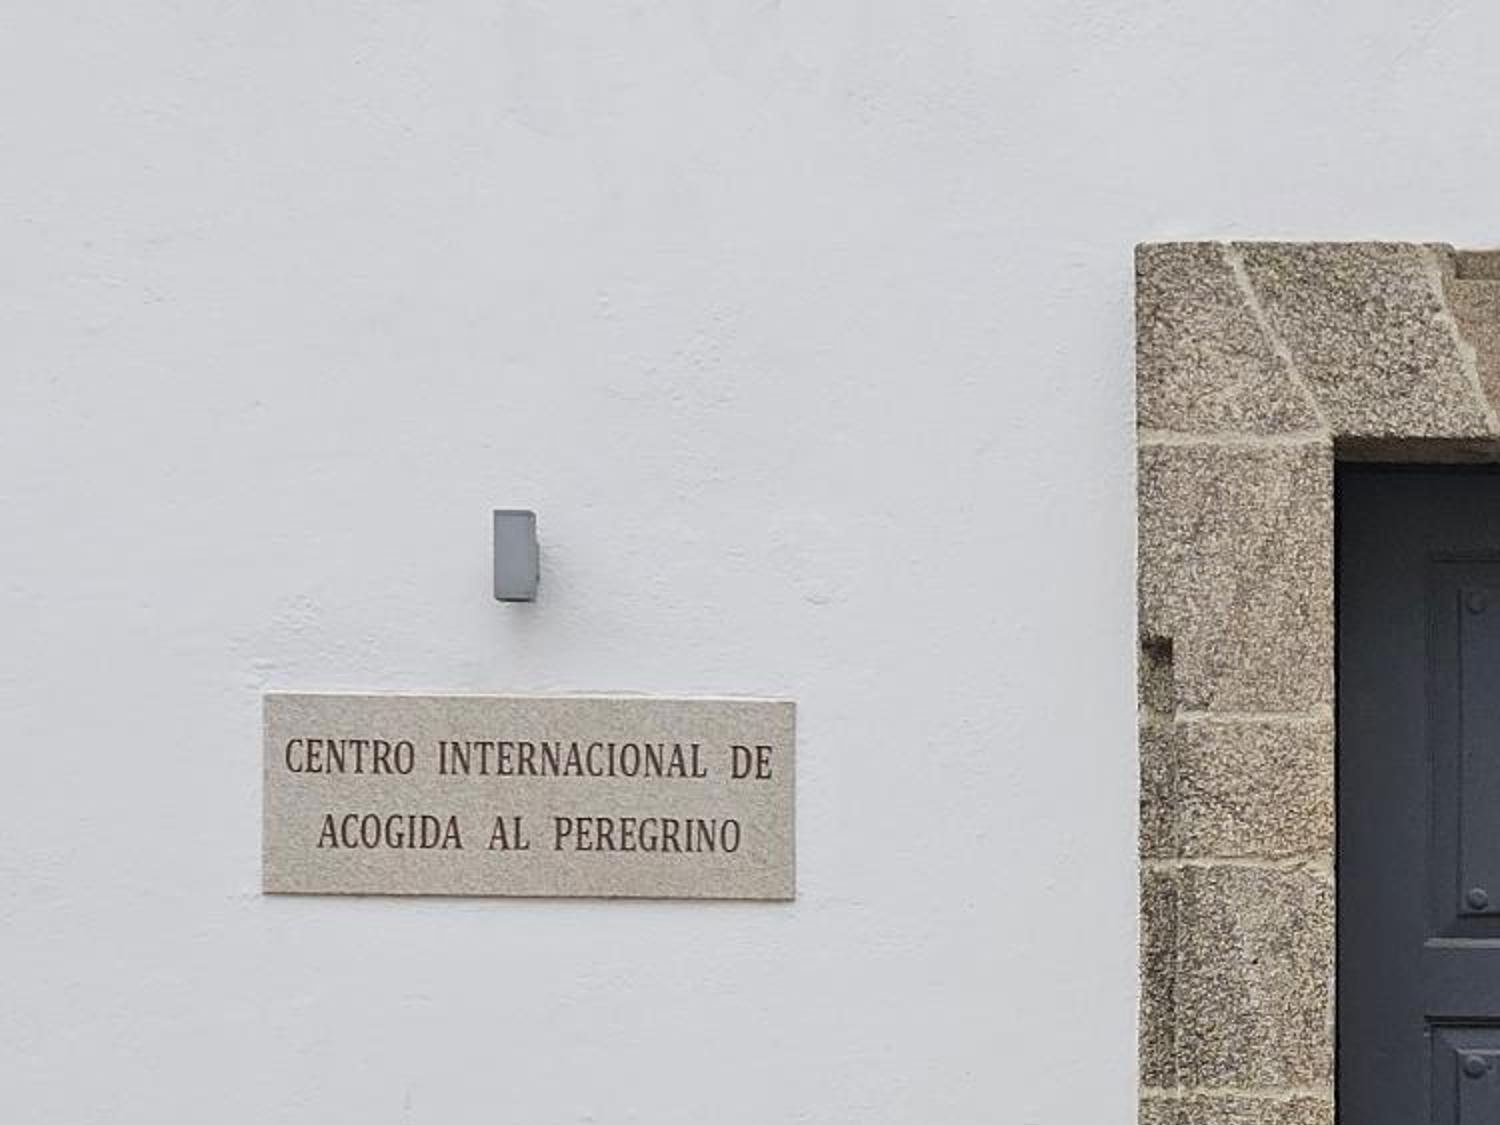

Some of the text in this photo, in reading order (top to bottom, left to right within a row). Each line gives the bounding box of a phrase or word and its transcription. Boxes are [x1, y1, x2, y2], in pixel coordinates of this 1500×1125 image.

[285, 738, 774, 780] CENTRO INTERNACIONAL DE
[316, 813, 741, 854] ACOGIDA AL PEREGRINO
